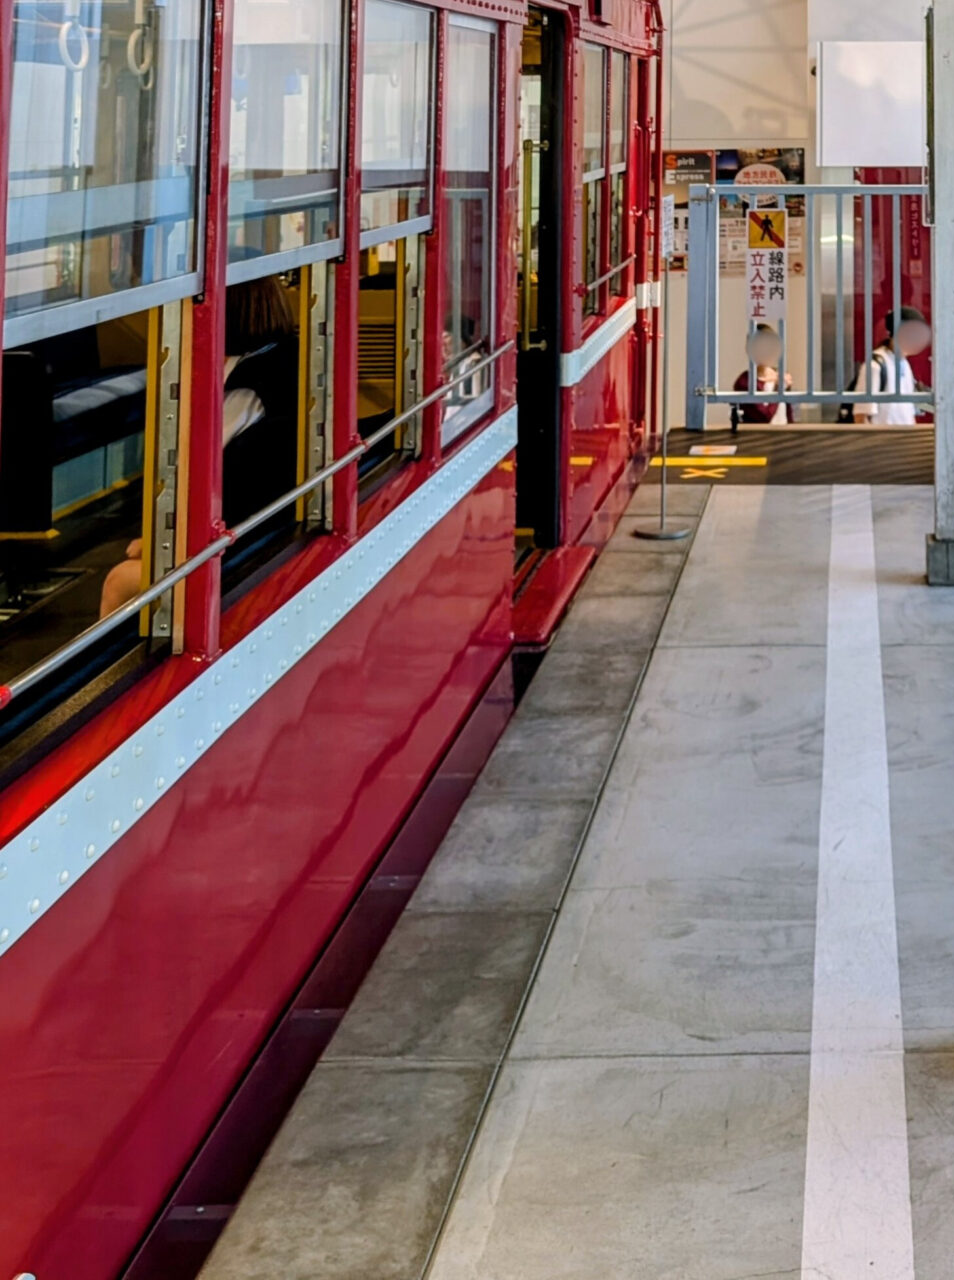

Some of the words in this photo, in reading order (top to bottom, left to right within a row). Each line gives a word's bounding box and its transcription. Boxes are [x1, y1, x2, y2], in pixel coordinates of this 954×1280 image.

[665, 154, 696, 169] Spirit
[665, 169, 705, 185] Express
[750, 251, 766, 317] 立入禁止
[768, 250, 785, 301] 線路内
